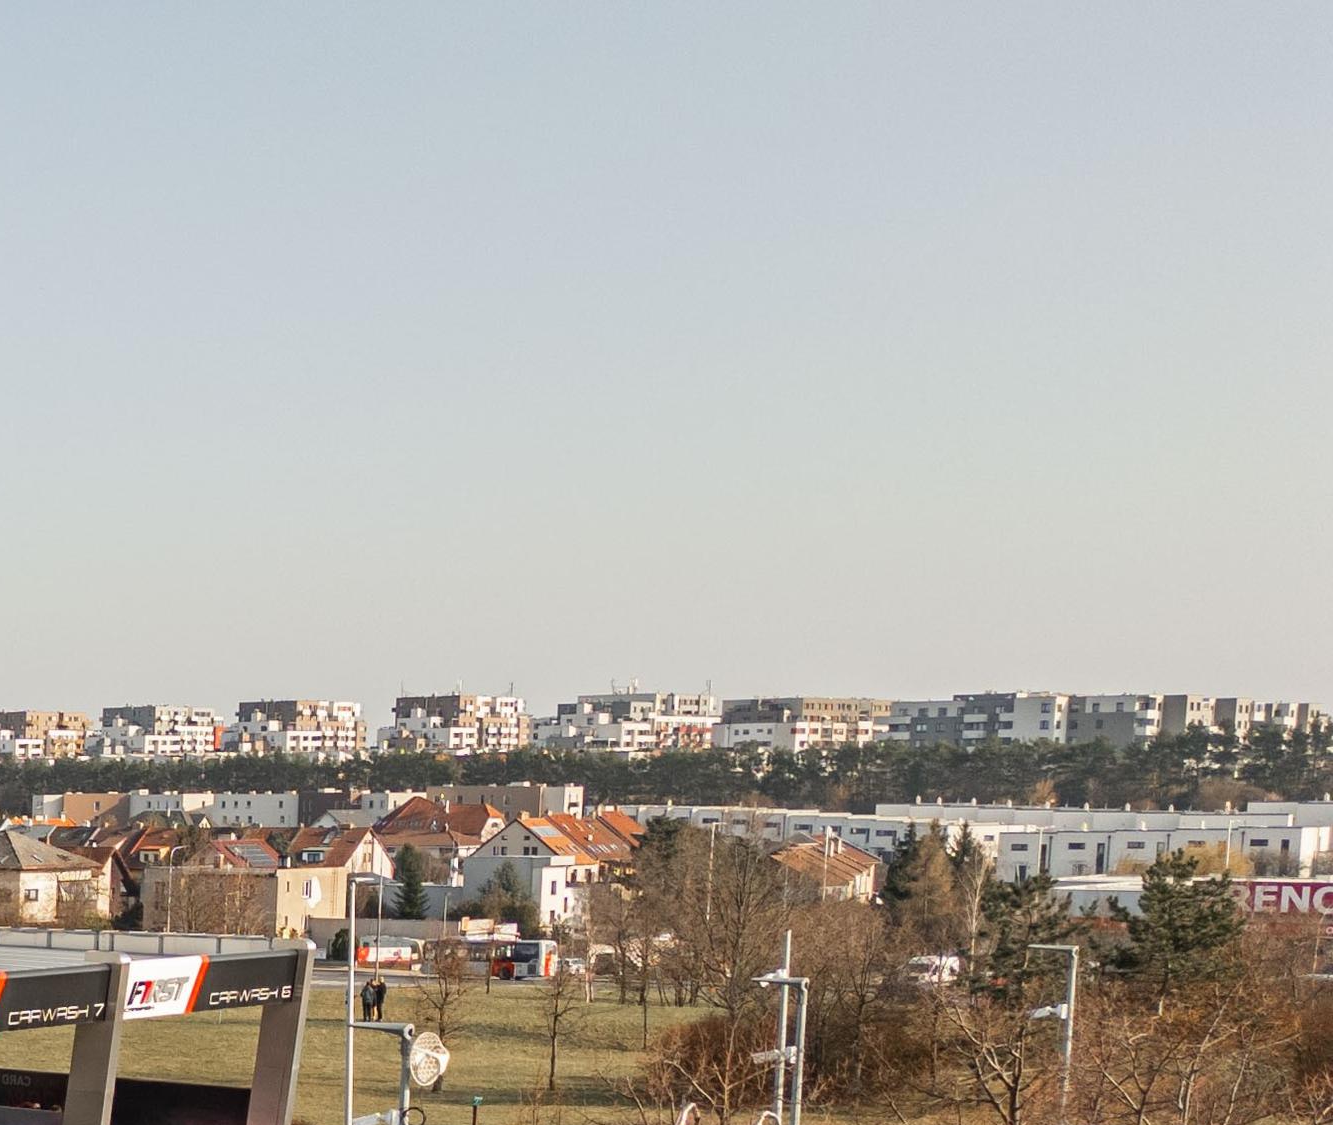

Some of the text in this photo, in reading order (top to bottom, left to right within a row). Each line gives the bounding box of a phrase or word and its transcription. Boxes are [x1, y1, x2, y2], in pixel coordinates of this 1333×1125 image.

[210, 985, 292, 1006] CARWASH 6
[8, 1003, 105, 1026] CARWASH 7
